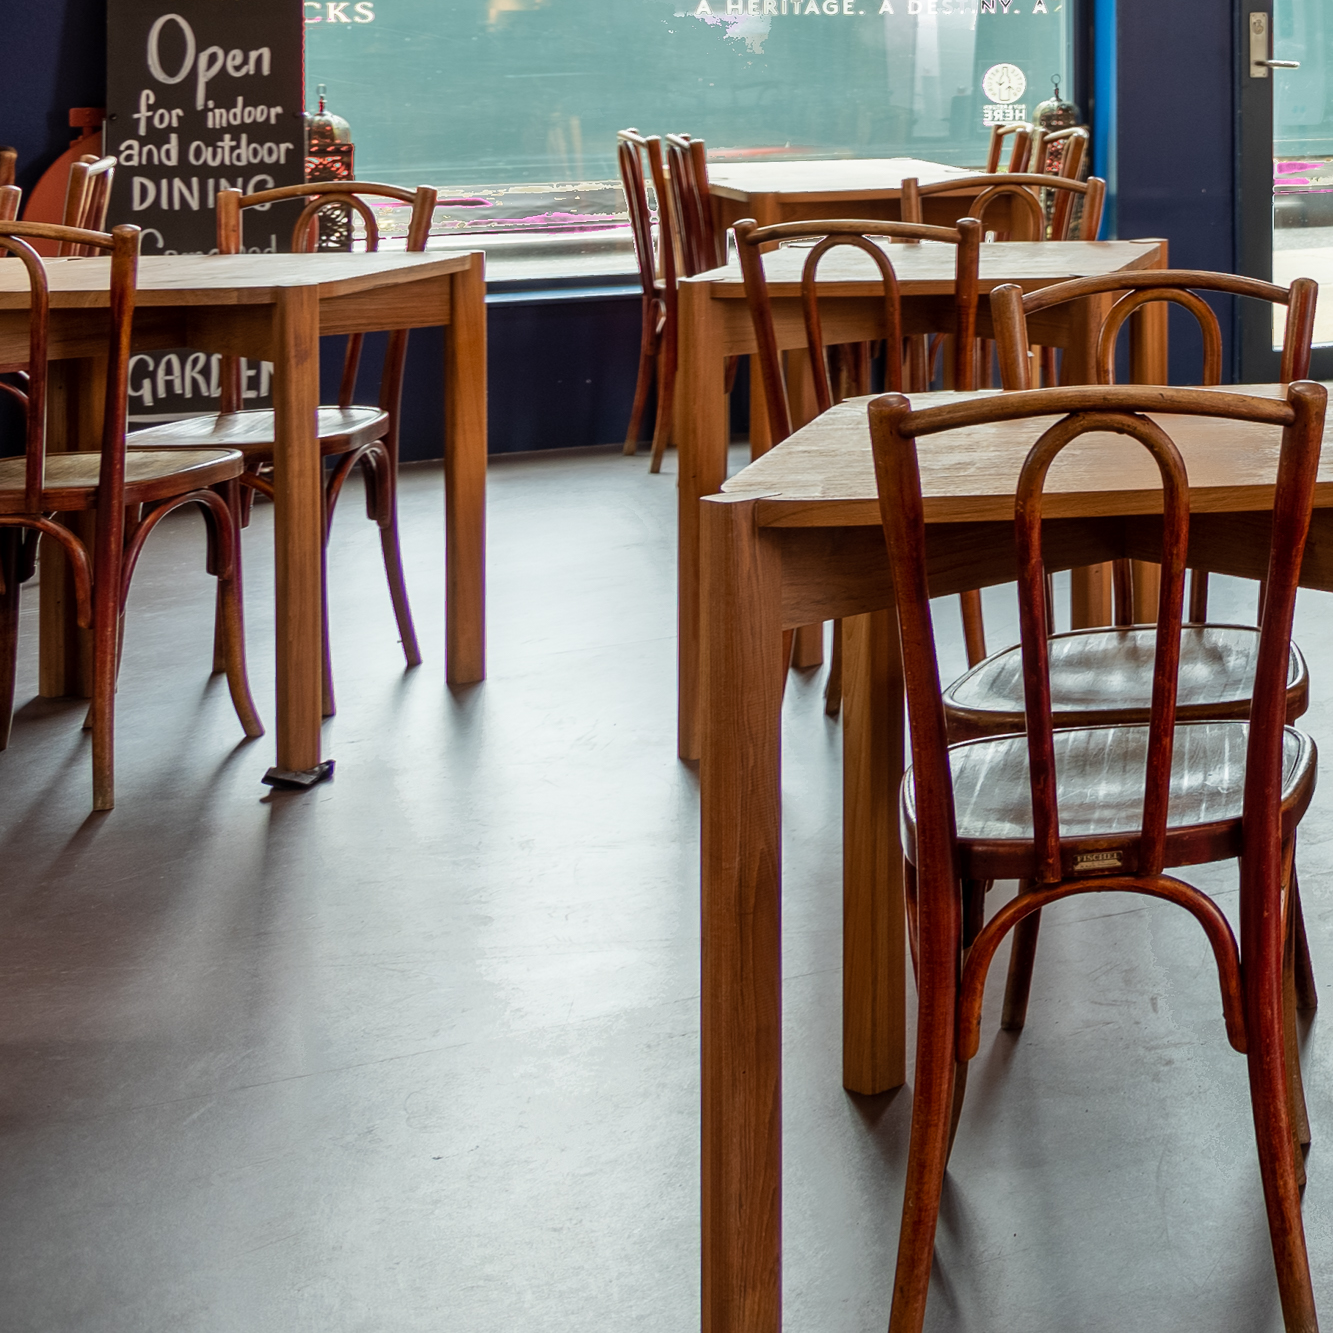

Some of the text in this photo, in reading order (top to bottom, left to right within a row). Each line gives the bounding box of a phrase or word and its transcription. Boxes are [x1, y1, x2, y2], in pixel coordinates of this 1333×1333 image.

[695, 0, 712, 15] A
[879, 0, 894, 15] A
[147, 14, 271, 110] Open
[133, 89, 283, 136] for indoor
[118, 134, 294, 166] and outdoor
